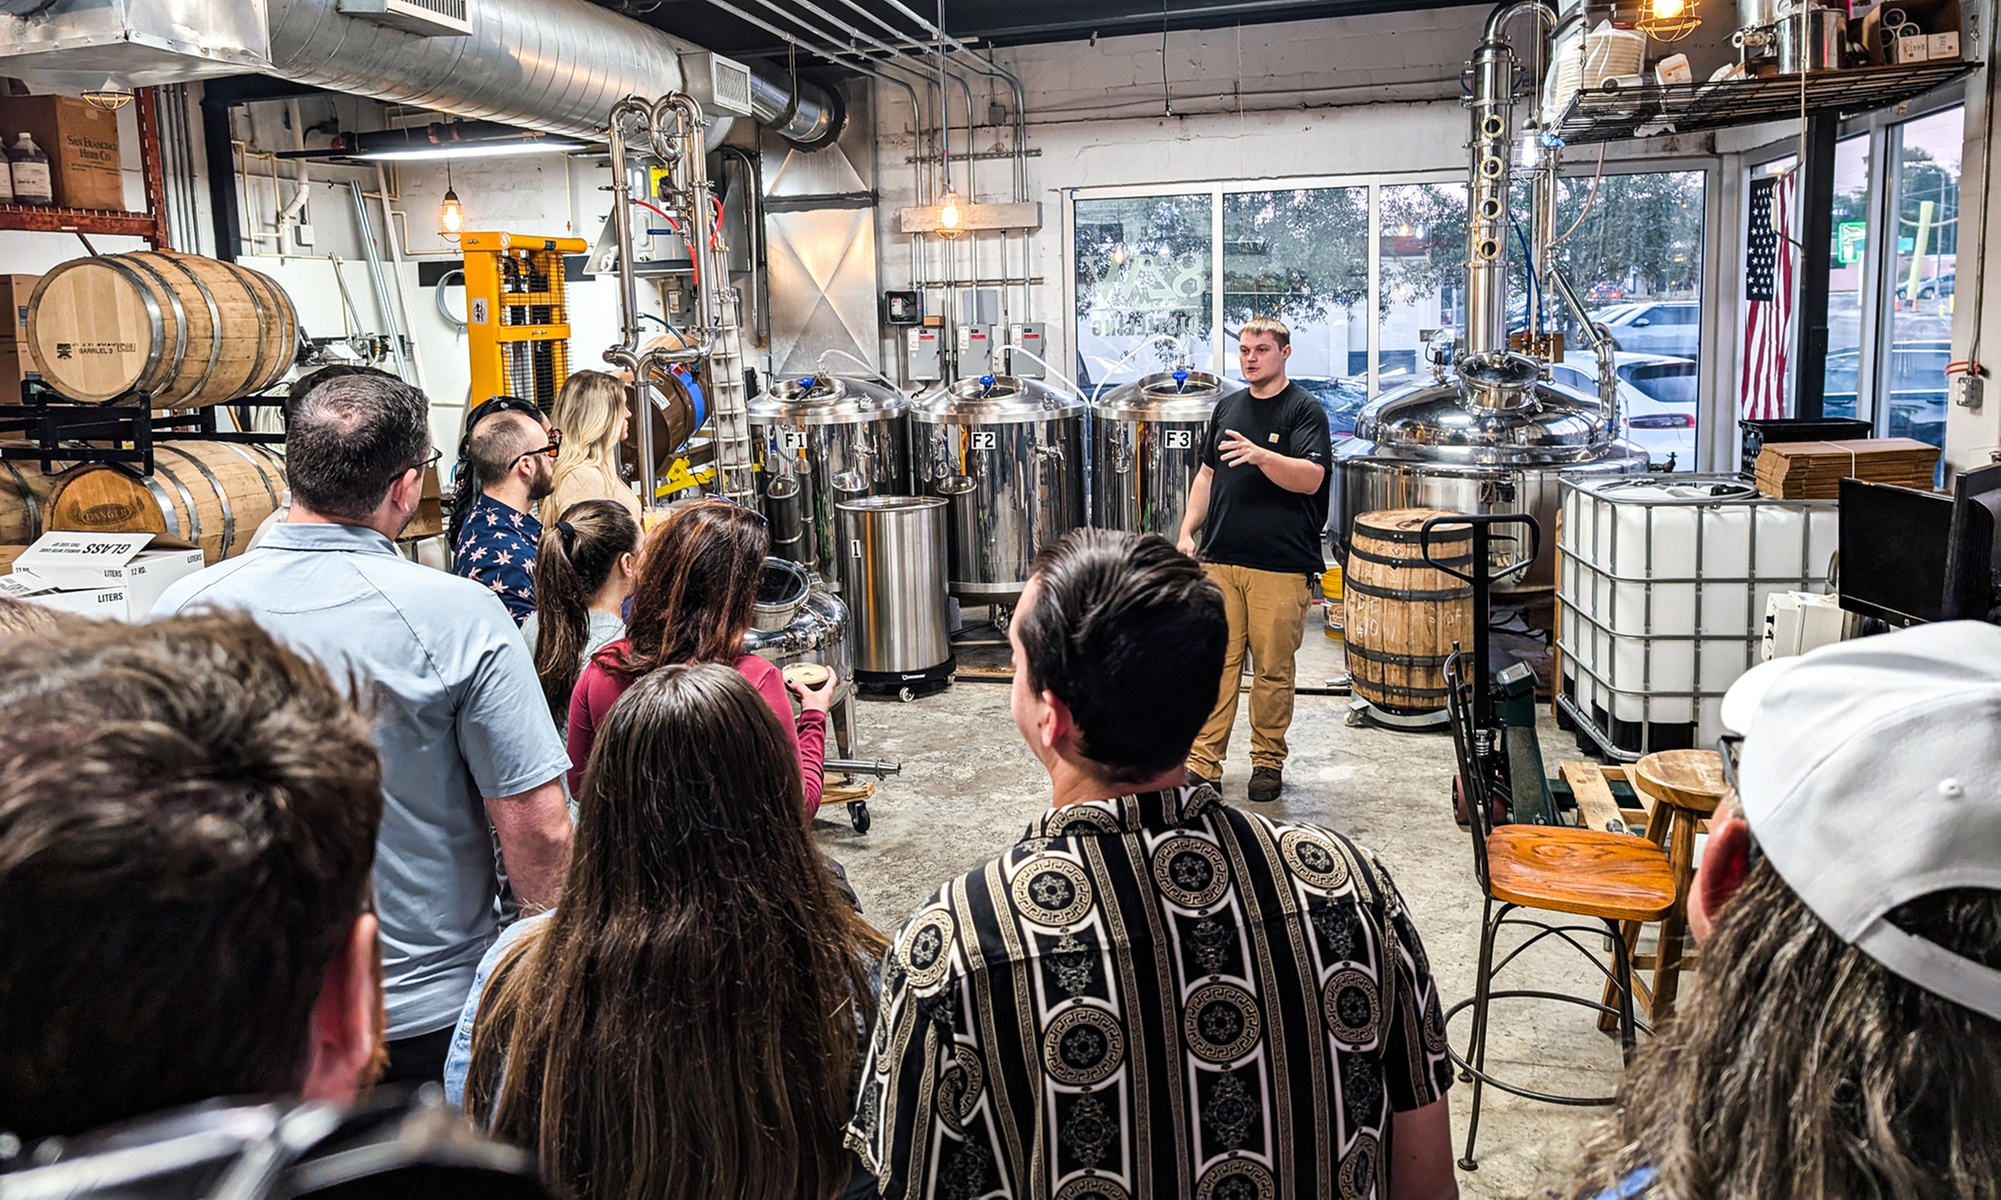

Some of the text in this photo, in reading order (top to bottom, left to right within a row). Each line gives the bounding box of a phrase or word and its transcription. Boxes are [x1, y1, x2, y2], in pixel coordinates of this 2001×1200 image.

[785, 434, 805, 447] F1
[973, 434, 994, 448] F2
[1167, 432, 1189, 447] F3
[82, 543, 132, 554] GLASS
[853, 542, 860, 556] 1
[187, 554, 203, 563] LITERS
[104, 570, 122, 578] LITERS
[97, 592, 124, 603] LITERS
